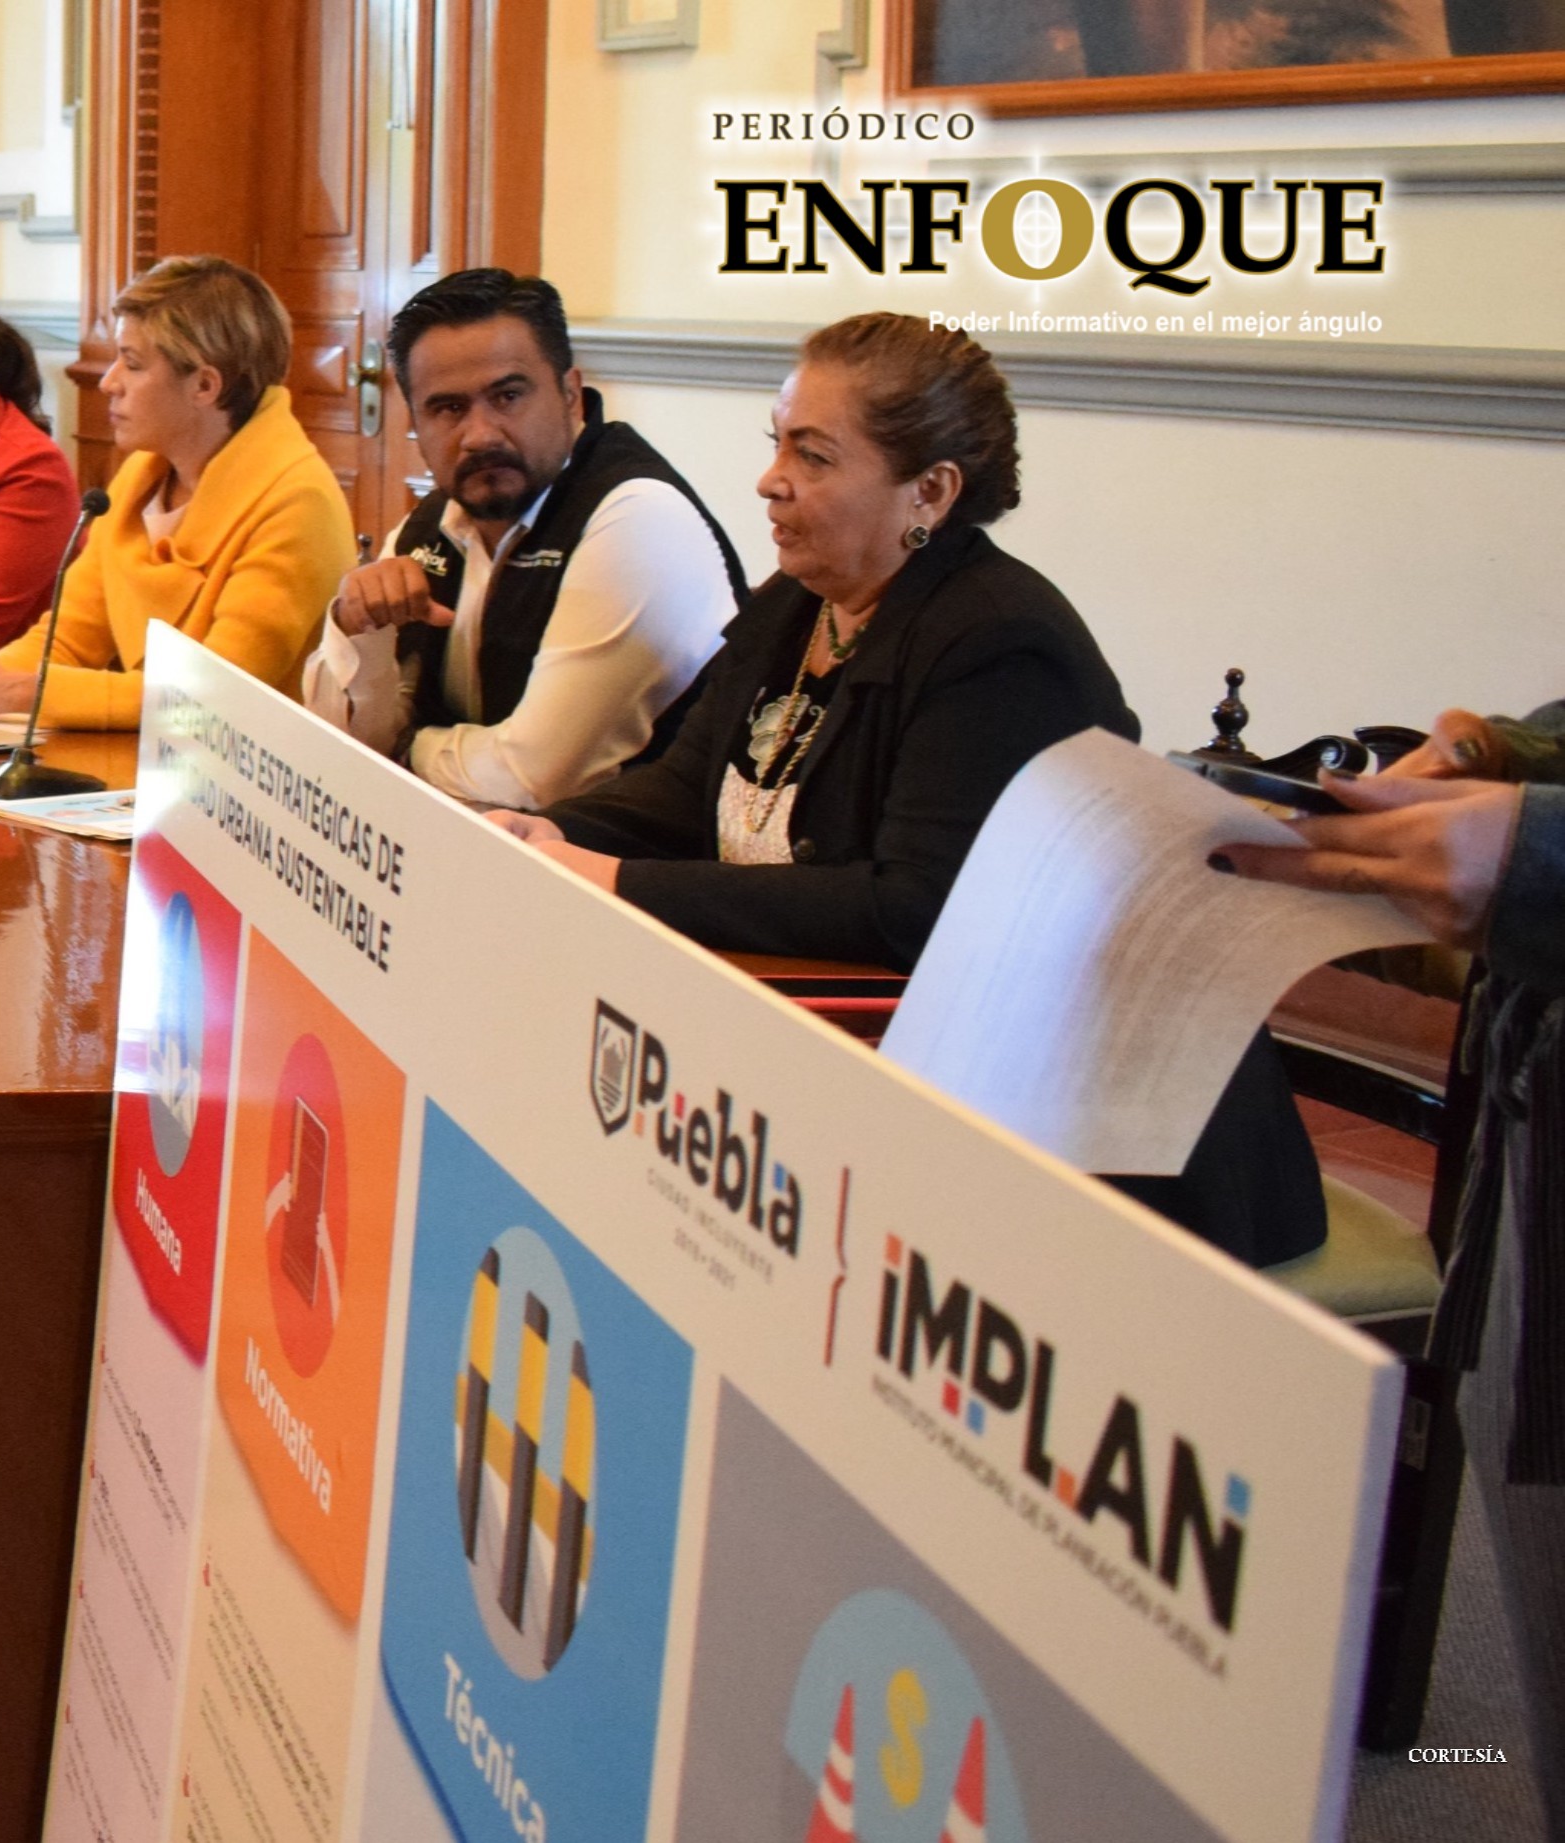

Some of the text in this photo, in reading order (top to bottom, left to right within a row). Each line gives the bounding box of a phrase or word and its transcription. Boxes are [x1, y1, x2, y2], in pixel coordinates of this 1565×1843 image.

[217, 786, 273, 871] URBANA
[275, 835, 392, 974] SUSTENTABLE
[257, 746, 373, 873] ESTRATÉGICAS
[376, 831, 405, 897] DE
[136, 1166, 182, 1277] Humana
[636, 1029, 802, 1260] Puebla
[244, 1335, 333, 1516] Normativa
[444, 1651, 546, 1843] Técnica
